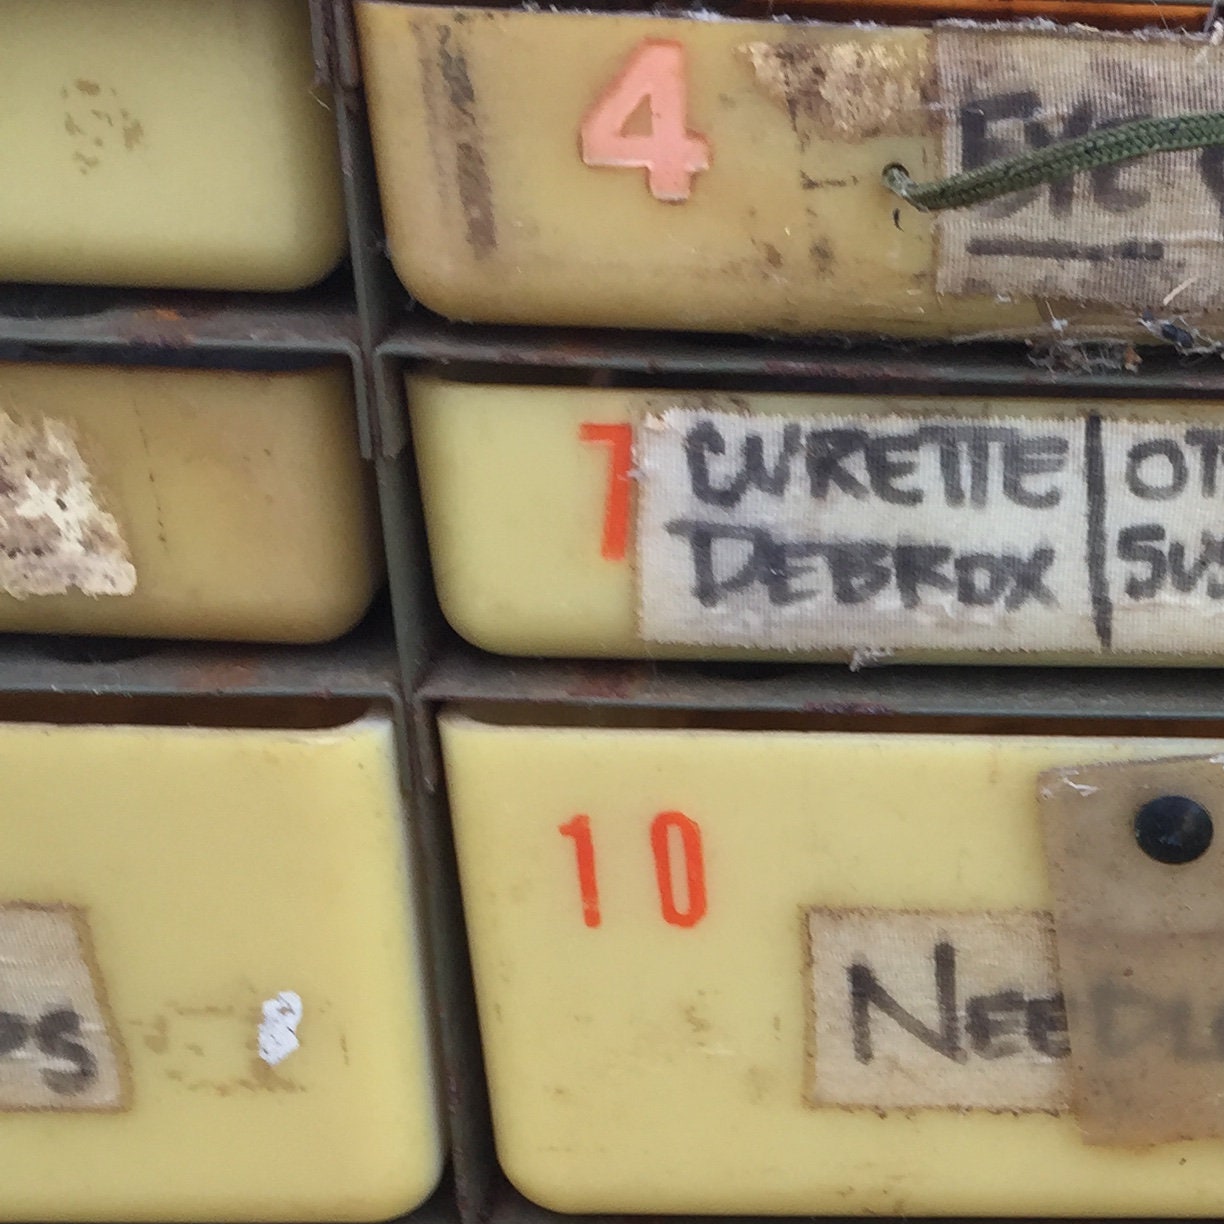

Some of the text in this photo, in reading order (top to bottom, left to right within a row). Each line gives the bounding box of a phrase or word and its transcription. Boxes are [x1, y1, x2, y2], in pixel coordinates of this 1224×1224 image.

[580, 37, 711, 202] 4
[579, 422, 633, 561] 7
[684, 420, 1069, 508] CURETTE
[664, 518, 1056, 610] DEBROX
[558, 810, 707, 929] 10
